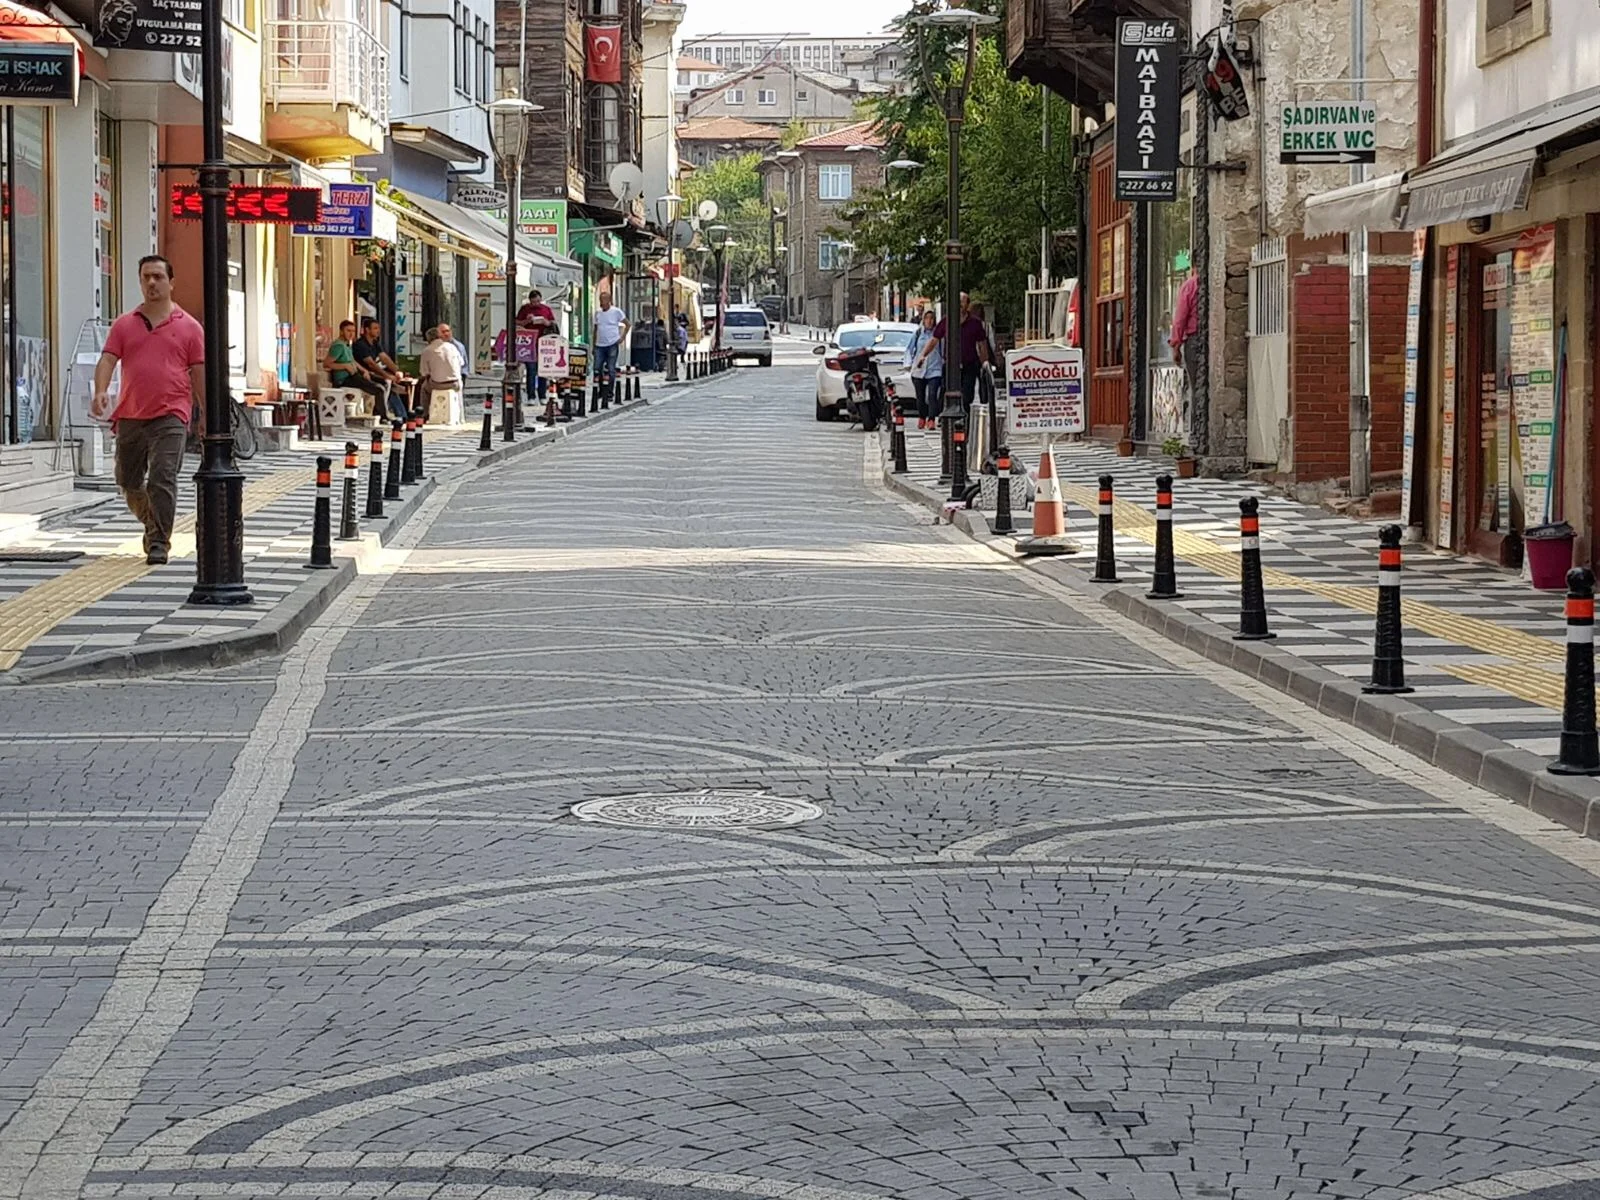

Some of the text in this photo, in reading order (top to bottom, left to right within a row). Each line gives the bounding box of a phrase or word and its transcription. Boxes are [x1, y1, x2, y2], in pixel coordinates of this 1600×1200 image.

[136, 18, 183, 30] UYGULAMA
[1146, 22, 1175, 38] sefa
[159, 34, 202, 47] 227 52
[1135, 48, 1161, 170] MATBAASI
[1283, 106, 1375, 129] ŞADIRVAN ve
[1283, 130, 1374, 150] ERKEK WC
[1125, 181, 1173, 190] 227 66 92
[331, 187, 370, 207] TERZİ
[1013, 365, 1078, 380] KÖKOĞLU
